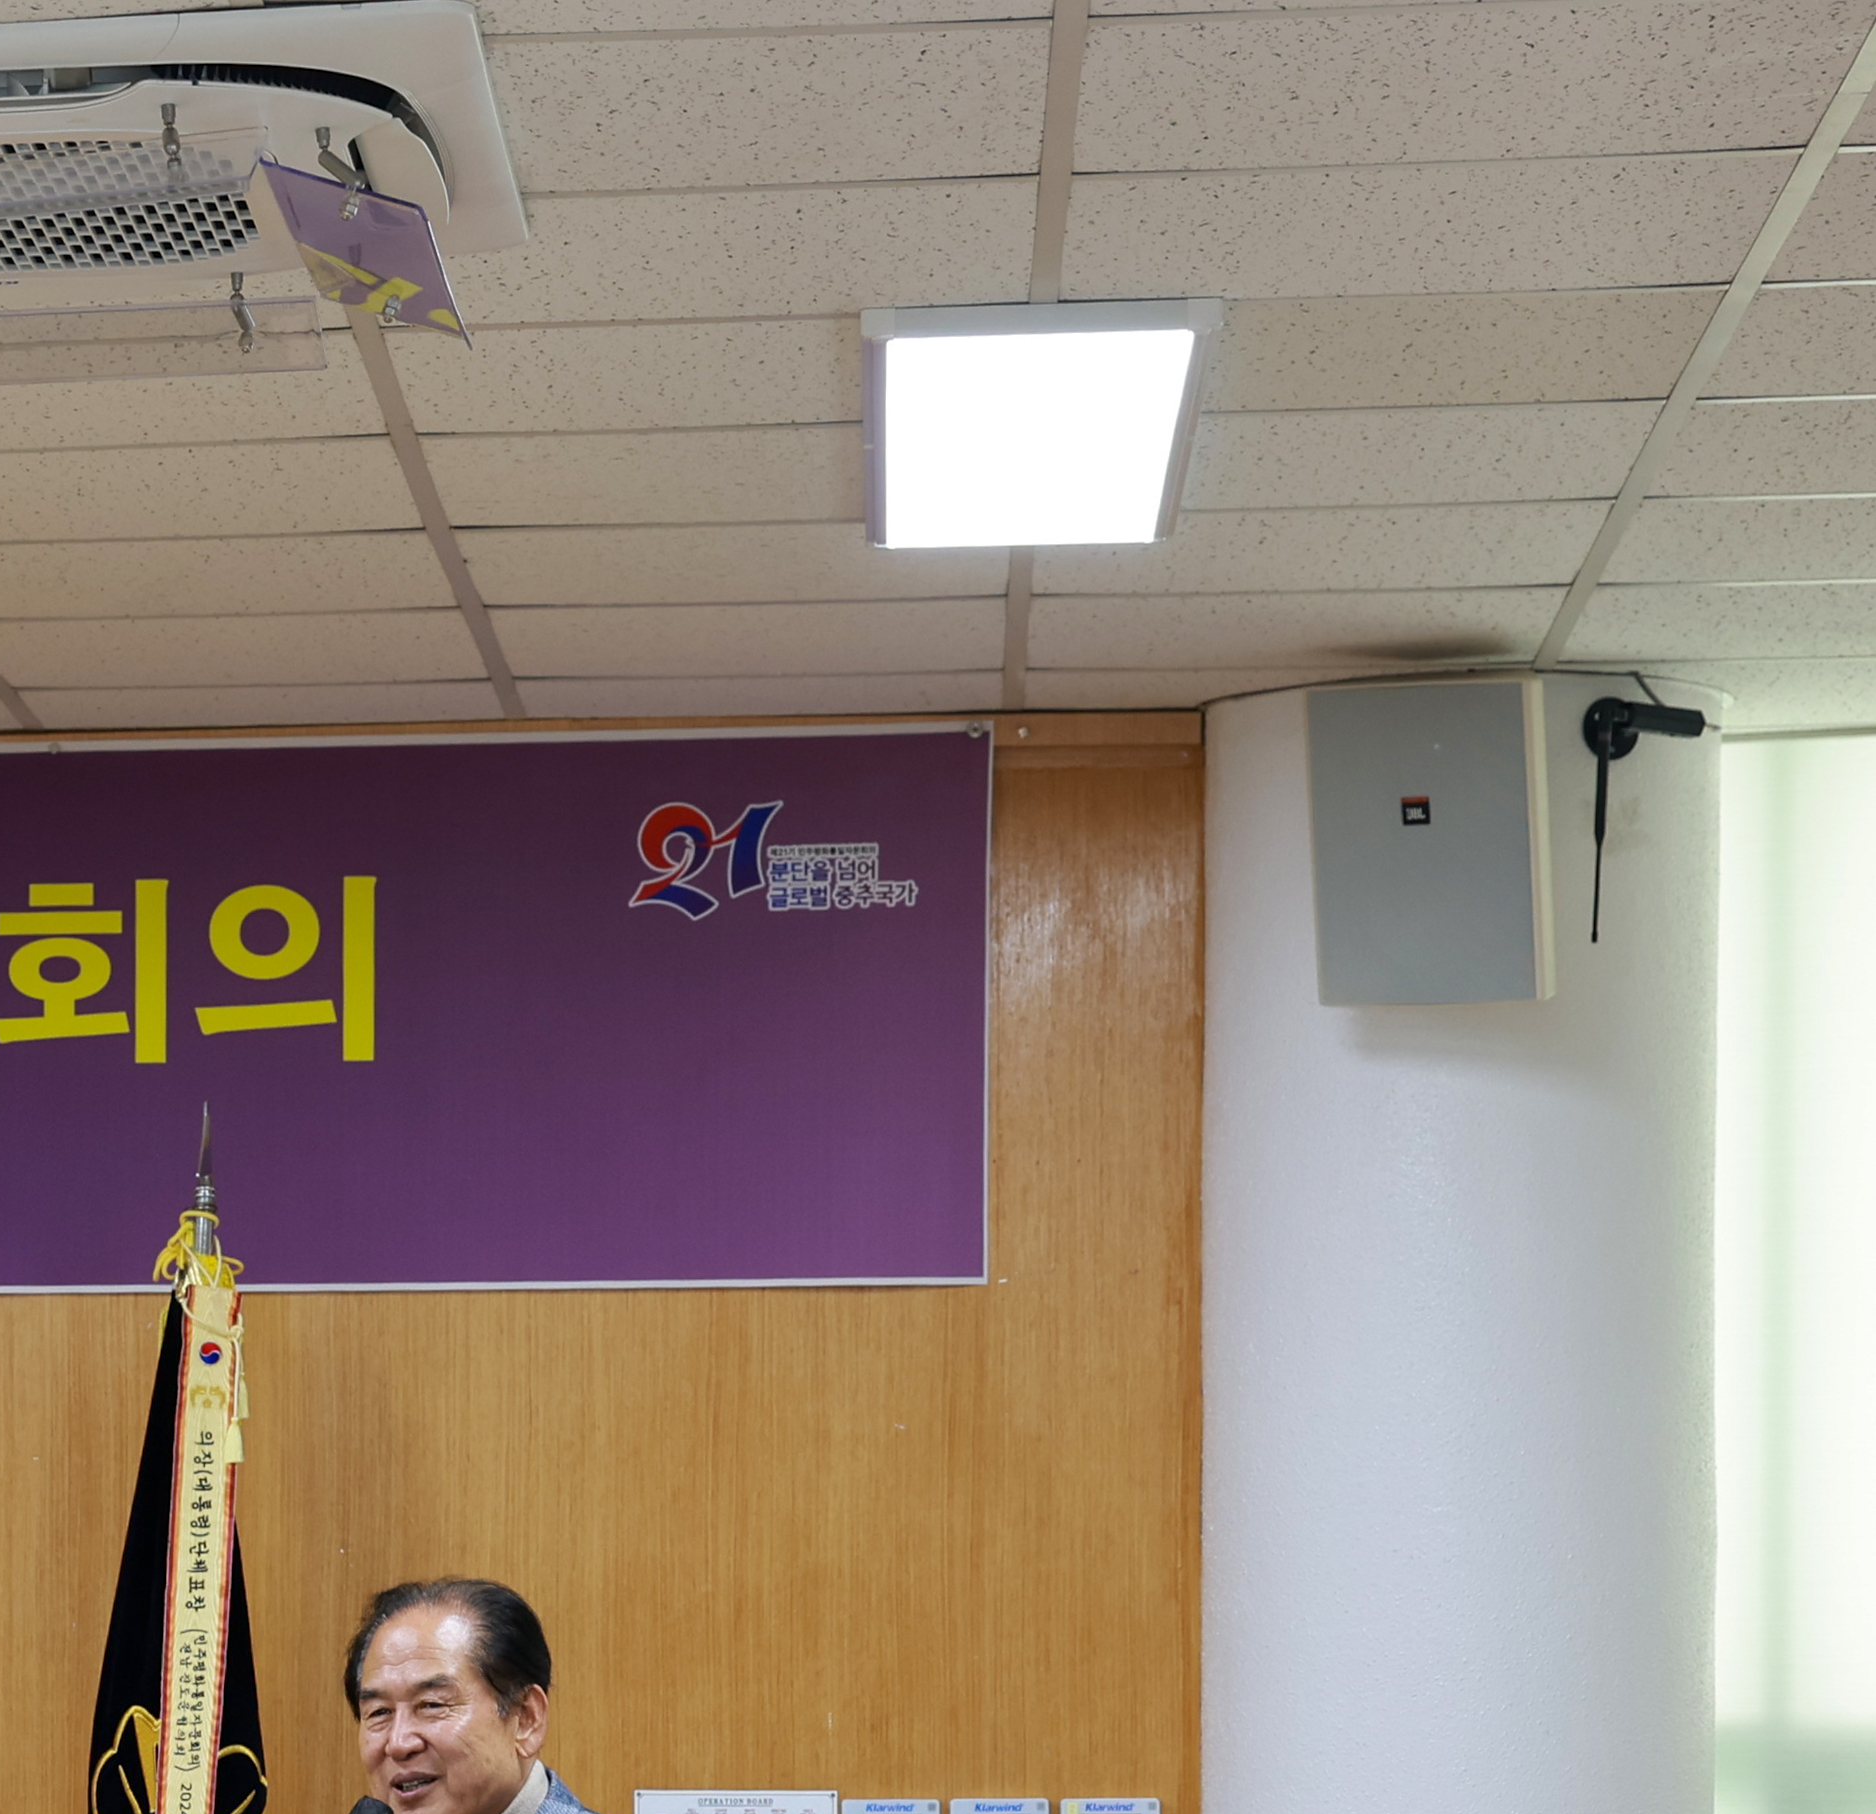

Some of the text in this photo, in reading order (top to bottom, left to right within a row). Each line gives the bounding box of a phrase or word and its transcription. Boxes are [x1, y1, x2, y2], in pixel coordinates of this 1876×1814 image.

[836, 860, 877, 882] 넘어
[769, 882, 916, 908] 글로벌 중추국가
[698, 1797, 774, 1806] OPERATION BOARD
[865, 1803, 915, 1813] Klarwind
[974, 1803, 1024, 1813] Klarwind
[1085, 1802, 1135, 1812] Klarwind
